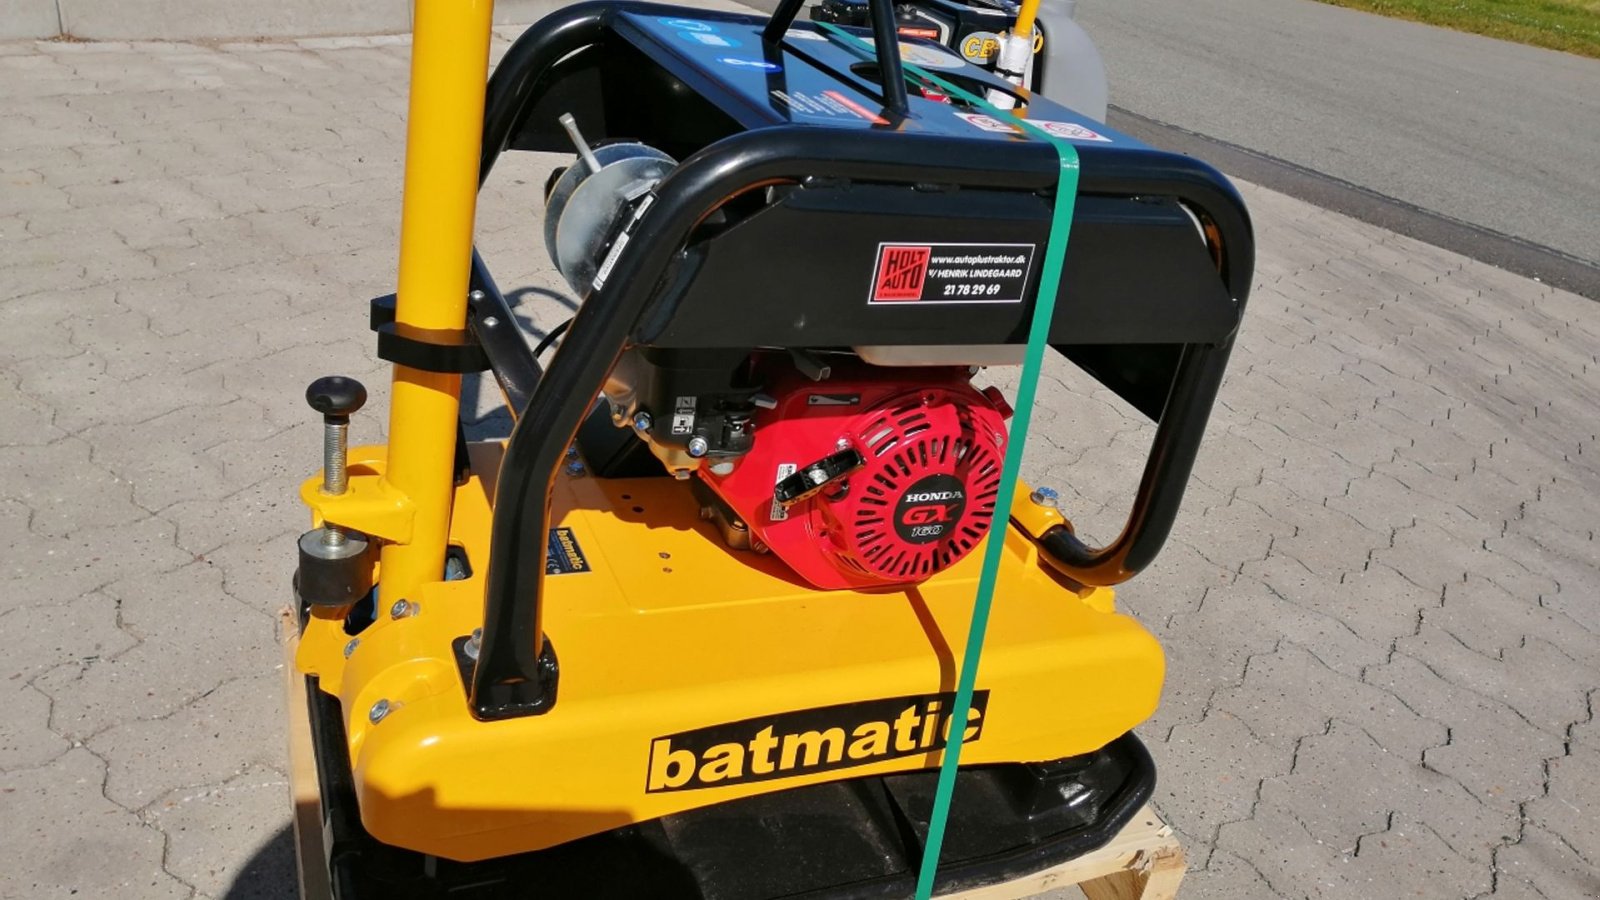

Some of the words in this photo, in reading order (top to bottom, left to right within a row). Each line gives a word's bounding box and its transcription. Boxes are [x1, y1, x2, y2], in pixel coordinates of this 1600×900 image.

[886, 250, 926, 277] HOLT
[931, 255, 1026, 265] www.autoplustraktor.dk
[881, 263, 922, 290] AUTO
[938, 268, 968, 278] HENRIK
[969, 268, 1022, 278] LINDEGAARD
[943, 285, 955, 296] 21
[957, 285, 970, 295] 78
[971, 285, 985, 295] 29
[986, 284, 1001, 295] 69
[905, 491, 963, 502] HONDA
[902, 503, 959, 525] GX
[911, 525, 943, 537] 160
[556, 530, 584, 570] batmatic
[648, 701, 981, 791] batmatic
